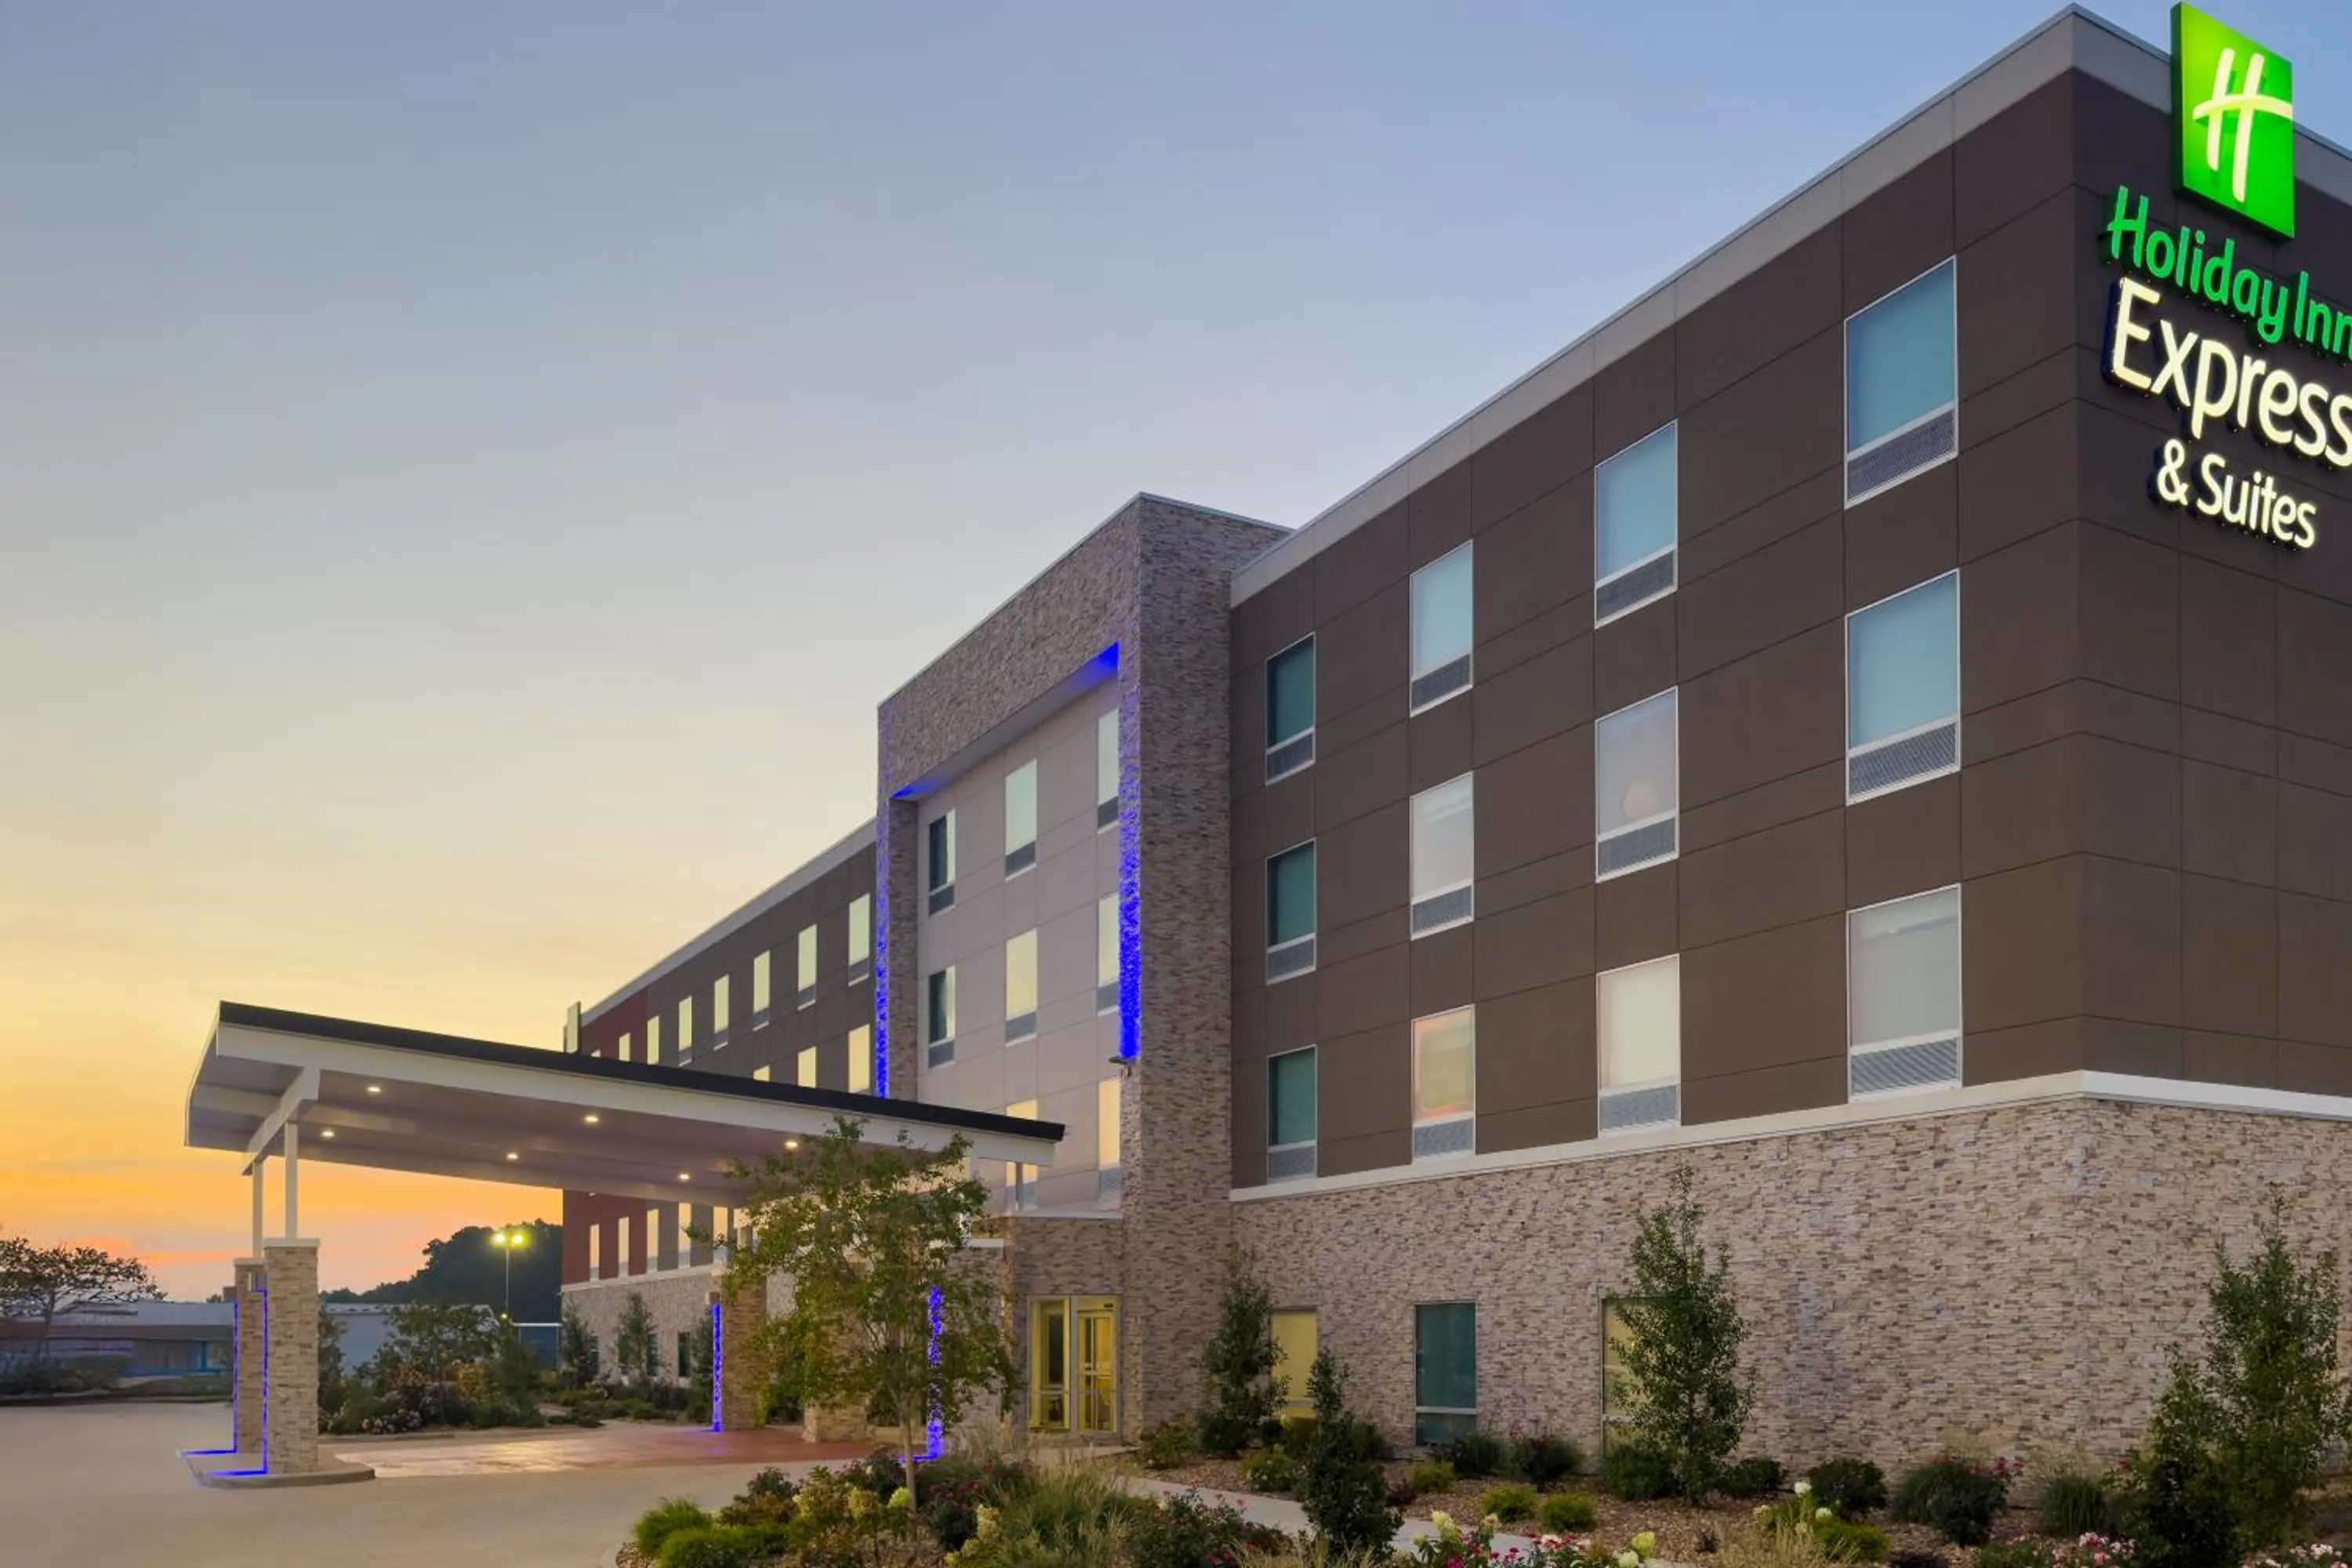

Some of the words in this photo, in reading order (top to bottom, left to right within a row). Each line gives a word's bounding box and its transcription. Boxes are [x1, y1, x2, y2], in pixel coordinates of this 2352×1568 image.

[2193, 48, 2292, 202] H
[2107, 186, 2287, 343] Holiday
[2294, 270, 2352, 361] Inn
[2111, 278, 2352, 466] Express
[2158, 438, 2189, 506] &
[2196, 454, 2317, 548] Suites
